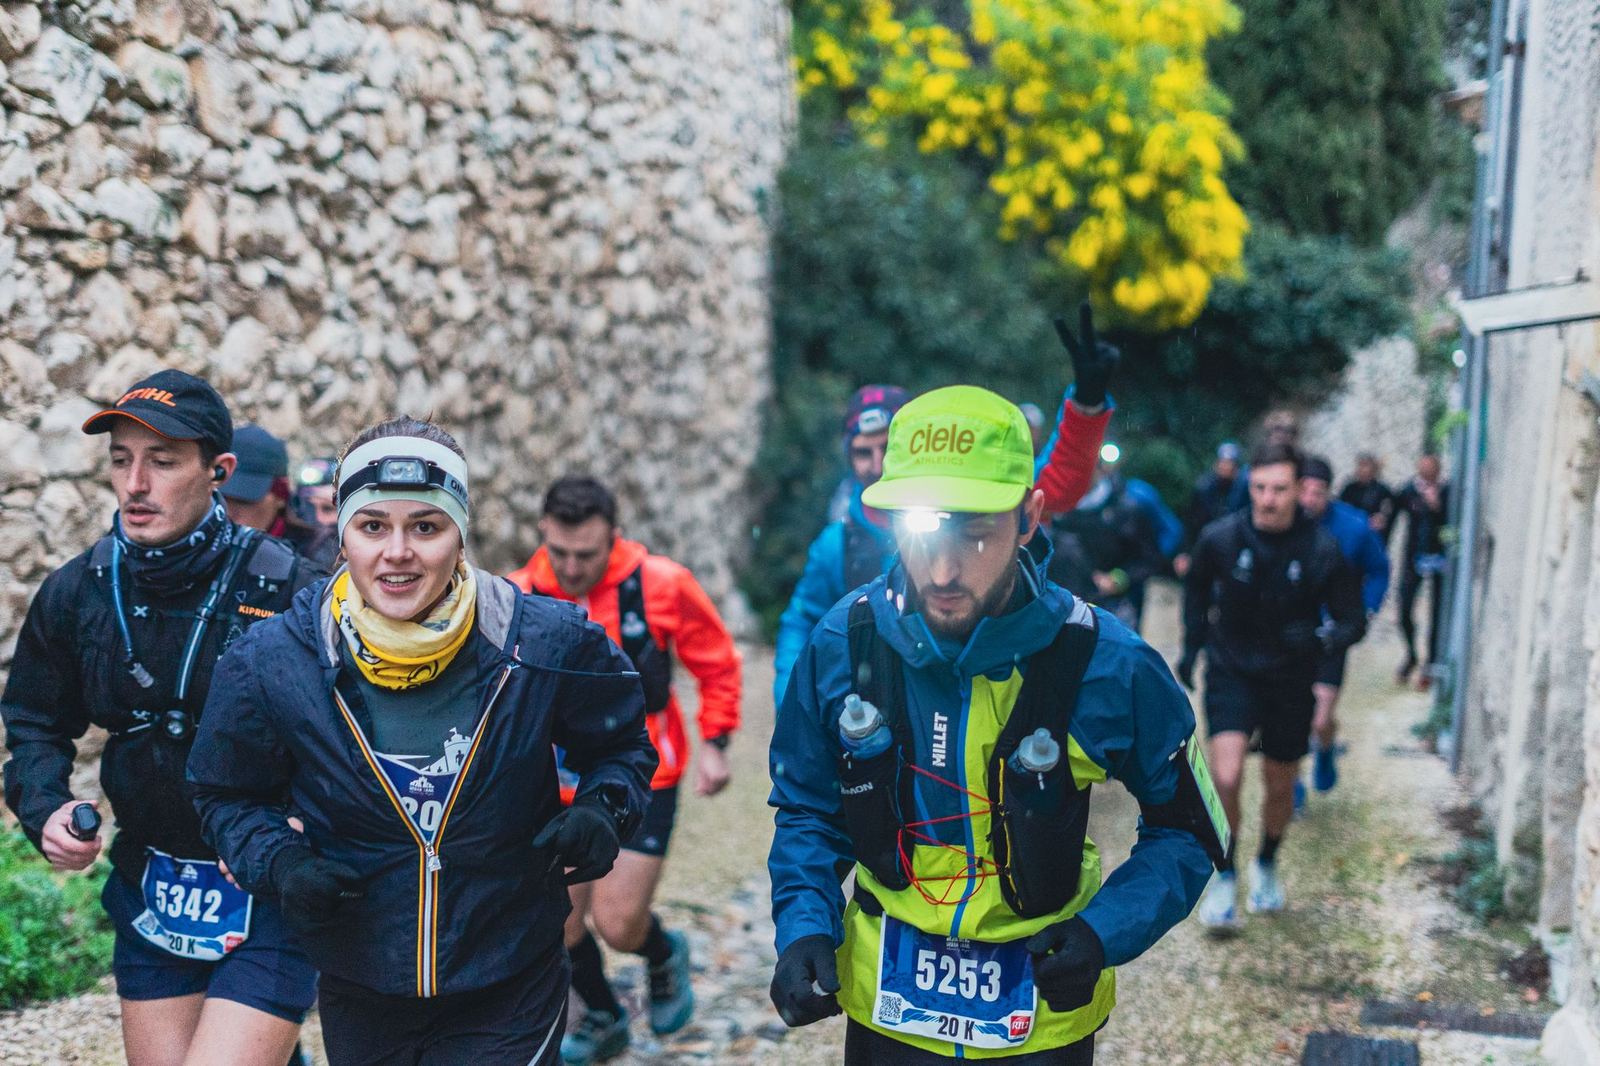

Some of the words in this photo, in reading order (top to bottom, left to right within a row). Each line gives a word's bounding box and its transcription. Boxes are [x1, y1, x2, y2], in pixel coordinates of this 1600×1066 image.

[116, 387, 176, 407] STIHL
[909, 423, 975, 455] ciele
[914, 456, 964, 466] ATHLETICS
[932, 711, 948, 767] MILLET
[155, 880, 222, 923] 5342
[168, 934, 183, 951] 20
[187, 938, 196, 954] K
[916, 949, 1001, 1002] 5253
[937, 1015, 959, 1037] 20
[964, 1020, 975, 1040] K
